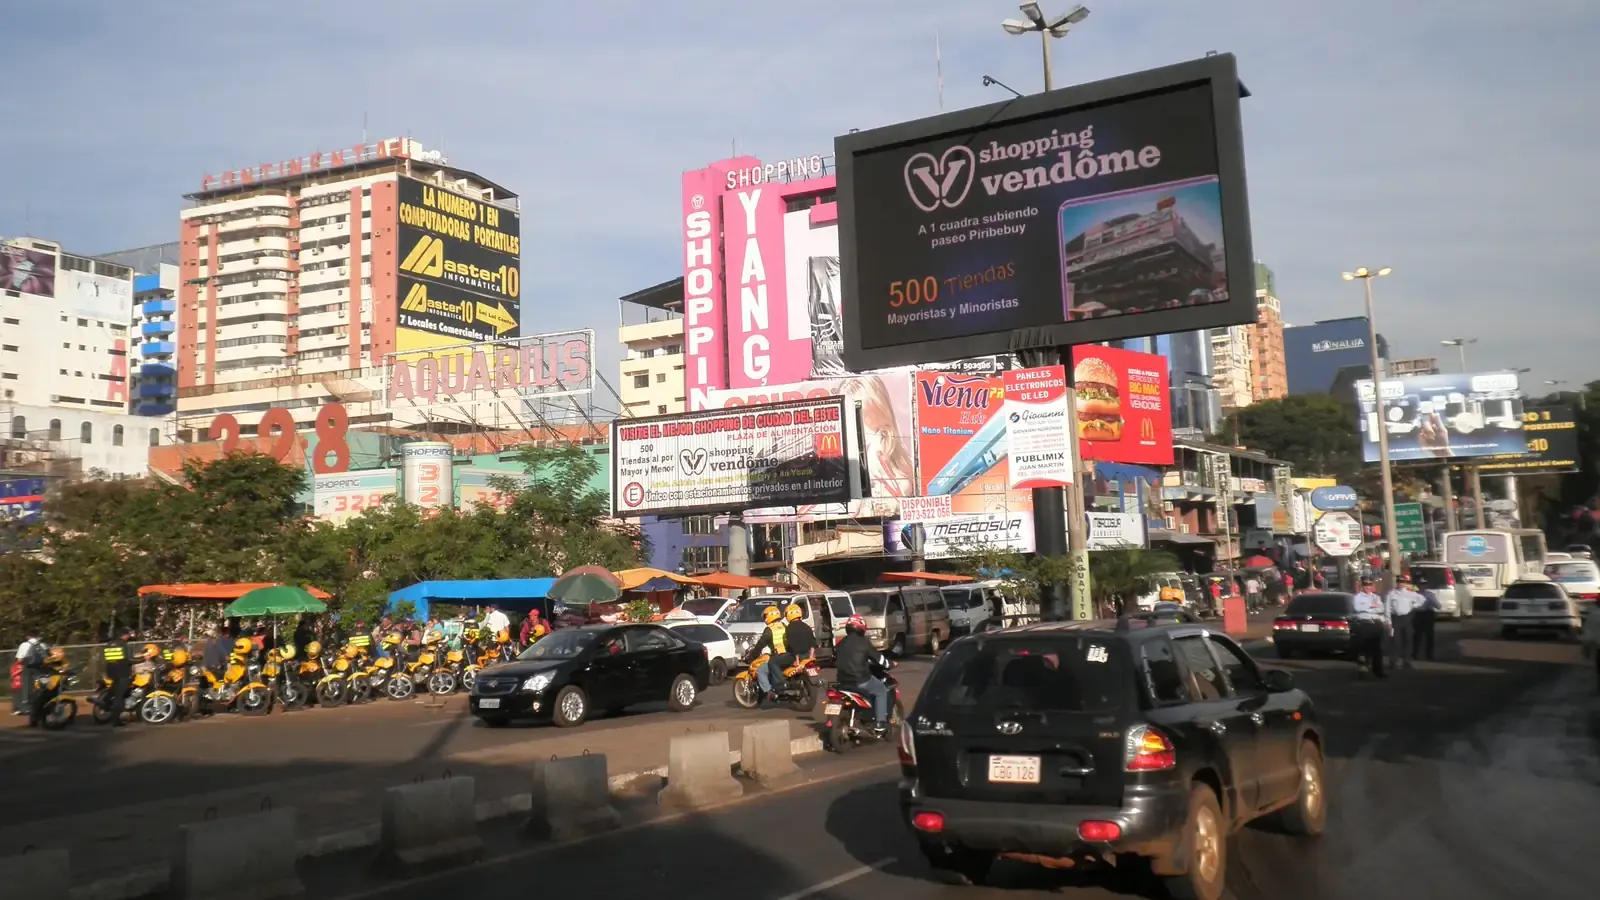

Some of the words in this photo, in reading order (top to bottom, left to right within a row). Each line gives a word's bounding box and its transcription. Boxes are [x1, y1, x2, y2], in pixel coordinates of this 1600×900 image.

[979, 125, 1095, 163] shopping
[202, 138, 411, 191] CONTINENTAL
[727, 154, 821, 189] SHOPPING
[981, 145, 1161, 195] vendôme
[423, 186, 435, 208] LA
[438, 190, 477, 221] NUMERO
[480, 204, 484, 223] 1
[487, 207, 499, 227] EN
[400, 202, 470, 242] COMPUTADORAS
[474, 225, 519, 255] PORTATILES
[918, 225, 927, 236] A
[930, 223, 936, 233] 1
[939, 217, 980, 232] cuadra
[982, 206, 1039, 224] subiendo
[931, 234, 966, 249] paseo
[969, 223, 1026, 241] Piribebuy
[889, 276, 938, 307] 500
[943, 262, 1015, 295] Tiendas
[887, 307, 947, 325] Mayoristas
[949, 306, 956, 319] y
[959, 298, 1019, 315] Minoristas
[400, 315, 406, 324] 7
[408, 318, 437, 332] Locales
[439, 322, 483, 341] Comerciales
[390, 339, 589, 403] AQUARIUS
[1016, 370, 1052, 381] PANELES
[919, 377, 990, 410] Viena
[1005, 379, 1064, 392] ELECTRONICOS
[1021, 392, 1032, 401] DE
[1033, 391, 1049, 399] LED
[620, 426, 648, 441] VISITE
[650, 424, 661, 438] EL
[663, 421, 693, 437] MEJOR
[694, 416, 740, 434] SHOPPING
[742, 415, 755, 429] DE
[756, 410, 792, 428] CIUDAD
[793, 408, 812, 425] DEL
[814, 406, 839, 422] ESTE
[921, 426, 941, 434] Nano
[943, 426, 974, 435] Titanium
[405, 448, 453, 457] SHOPPING
[640, 443, 653, 453] 500
[709, 444, 754, 458] shopping
[1015, 452, 1065, 463] PUBLIMIX
[621, 455, 649, 465] Tiendas
[652, 454, 658, 462] al
[621, 467, 642, 477] Mayor
[316, 479, 360, 490] SHOPPING
[669, 490, 683, 500] con
[685, 479, 752, 499] estacionamientos
[754, 480, 791, 494] privados
[791, 482, 801, 491] en
[803, 480, 811, 489] el
[813, 477, 844, 488] interior
[335, 493, 382, 512] 328
[901, 496, 950, 510] DISPONIBLE
[903, 510, 935, 521] 0973-522
[937, 507, 951, 518] 056
[933, 519, 1022, 536] MERCOSUR
[1017, 765, 1034, 780] 126
